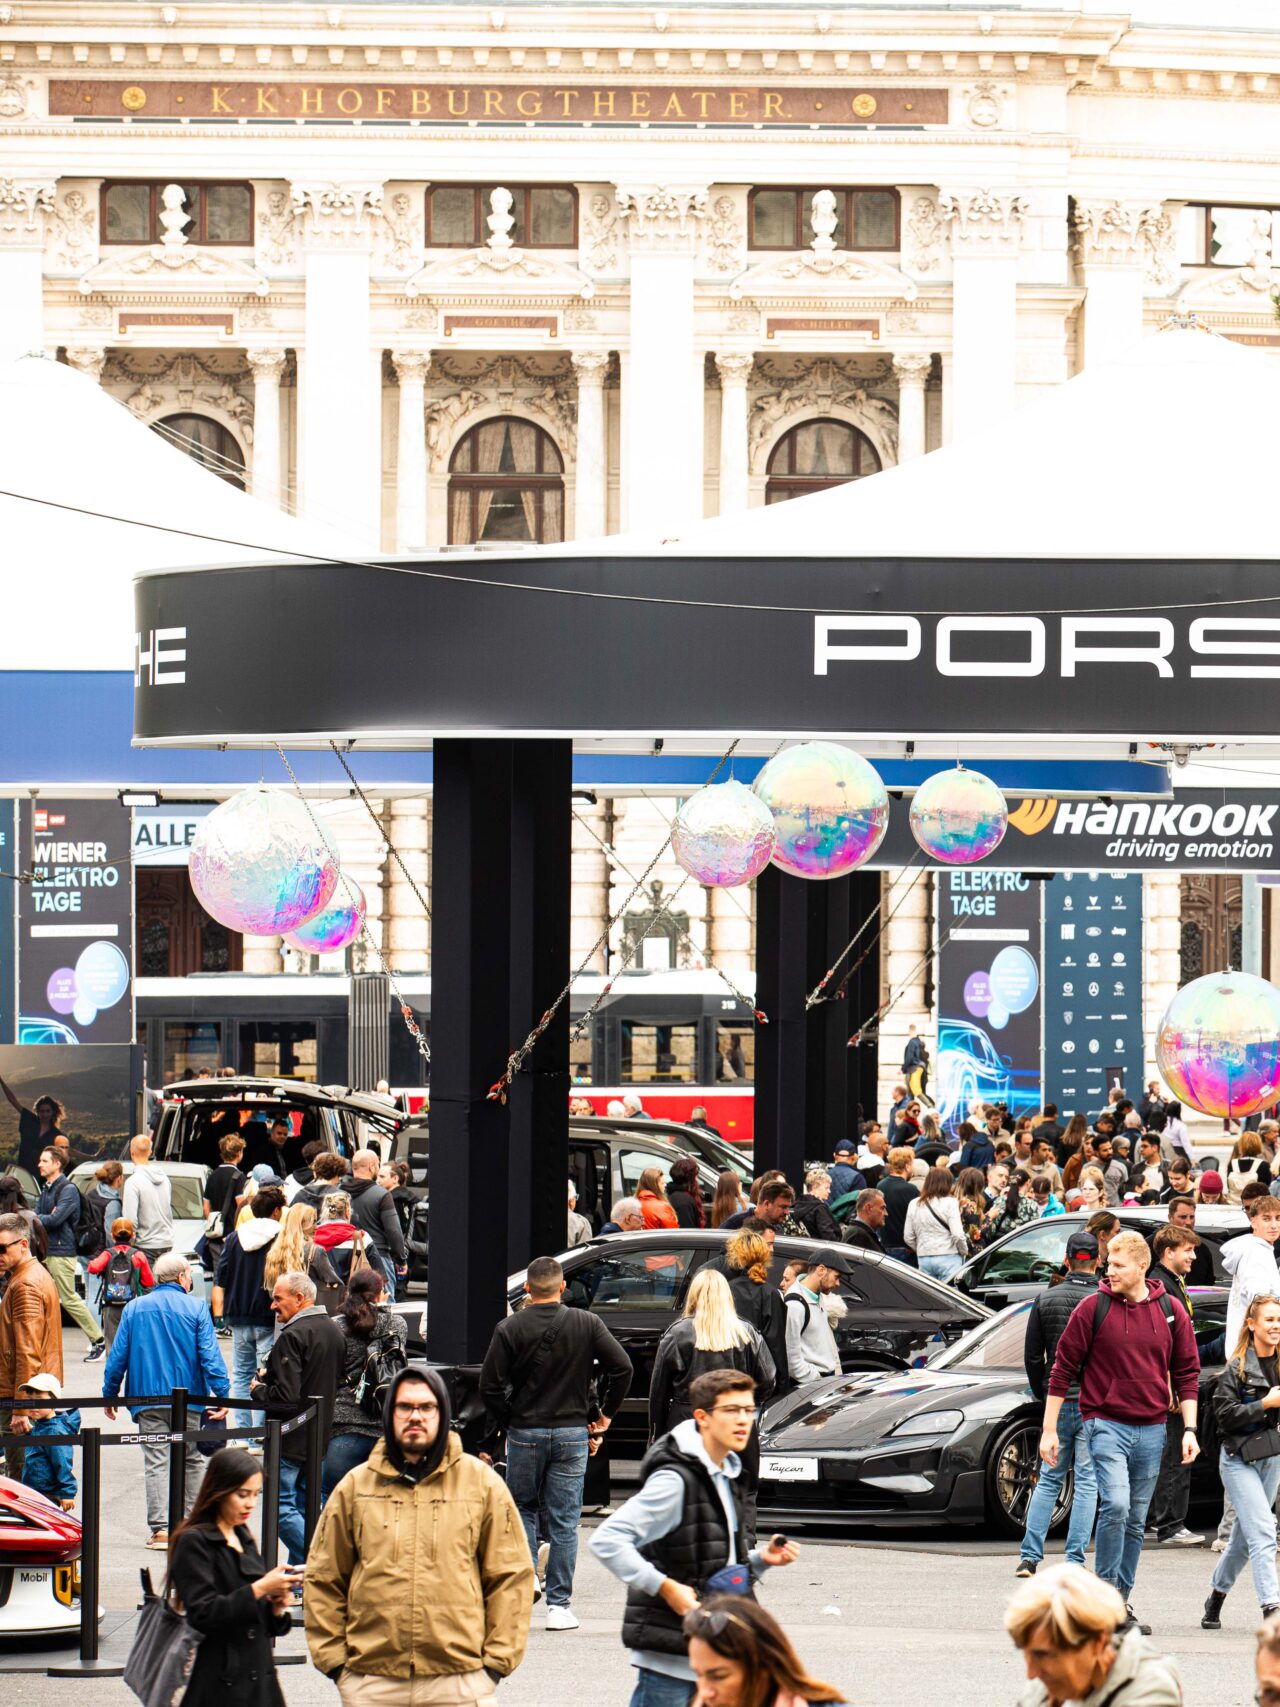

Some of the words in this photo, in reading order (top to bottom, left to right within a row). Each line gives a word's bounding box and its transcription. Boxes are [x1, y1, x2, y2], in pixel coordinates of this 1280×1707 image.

[134, 627, 187, 688] HE
[34, 841, 108, 863] WIENER
[1105, 838, 1178, 862] driving
[1184, 839, 1273, 858] emotion
[32, 866, 119, 888] ELEKTRO
[950, 871, 1030, 892] ELEKTRO
[31, 891, 82, 912] TAGE
[950, 895, 997, 916] TAGE
[120, 1433, 183, 1443] PORSCHE
[769, 1462, 804, 1475] Taycan
[20, 1572, 48, 1582] Mobil
